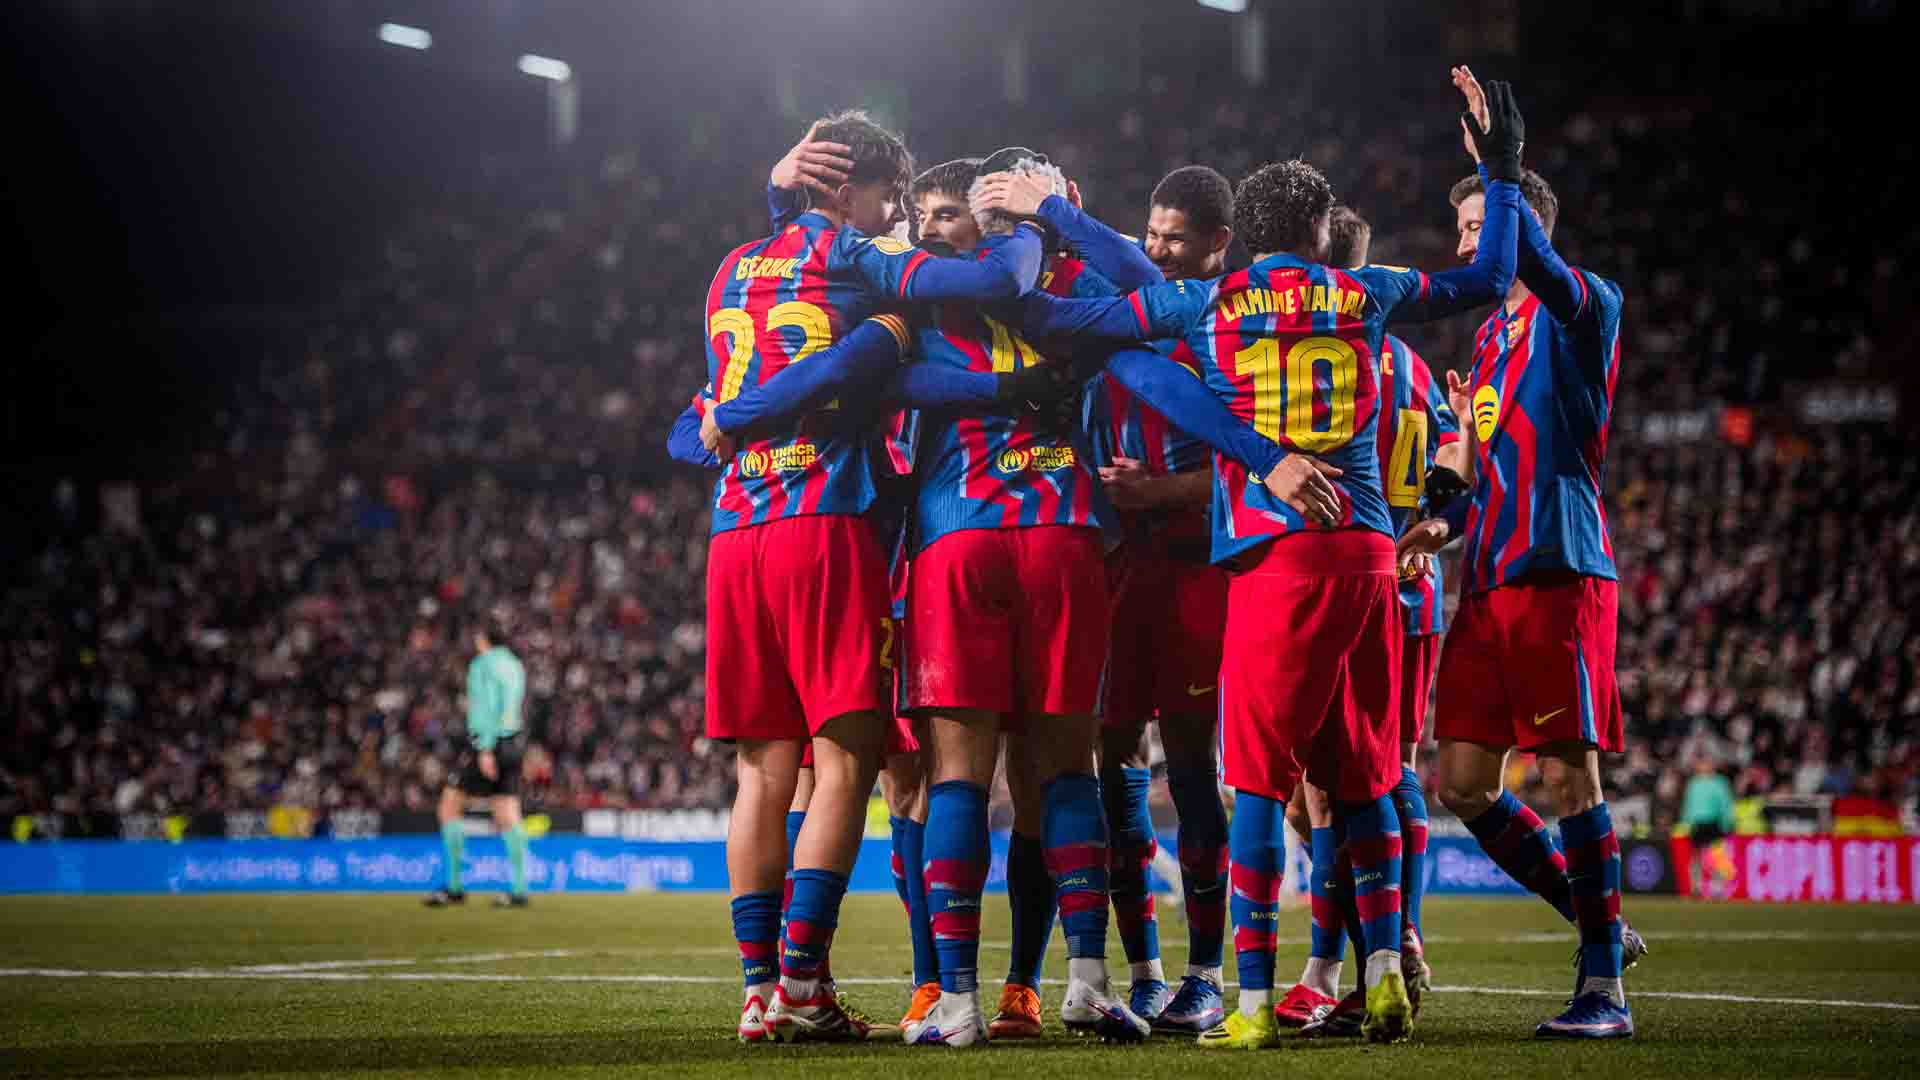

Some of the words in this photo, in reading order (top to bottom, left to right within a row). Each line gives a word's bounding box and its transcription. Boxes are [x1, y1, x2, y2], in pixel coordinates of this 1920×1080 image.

[735, 255, 801, 280] BERNAL
[1219, 287, 1296, 322] LAMINE
[1299, 285, 1366, 320] YAMAL
[1235, 337, 1357, 453] 10
[769, 444, 816, 459] UNHCR
[1030, 446, 1073, 457] UNHCR
[1031, 455, 1074, 469] ACNUR
